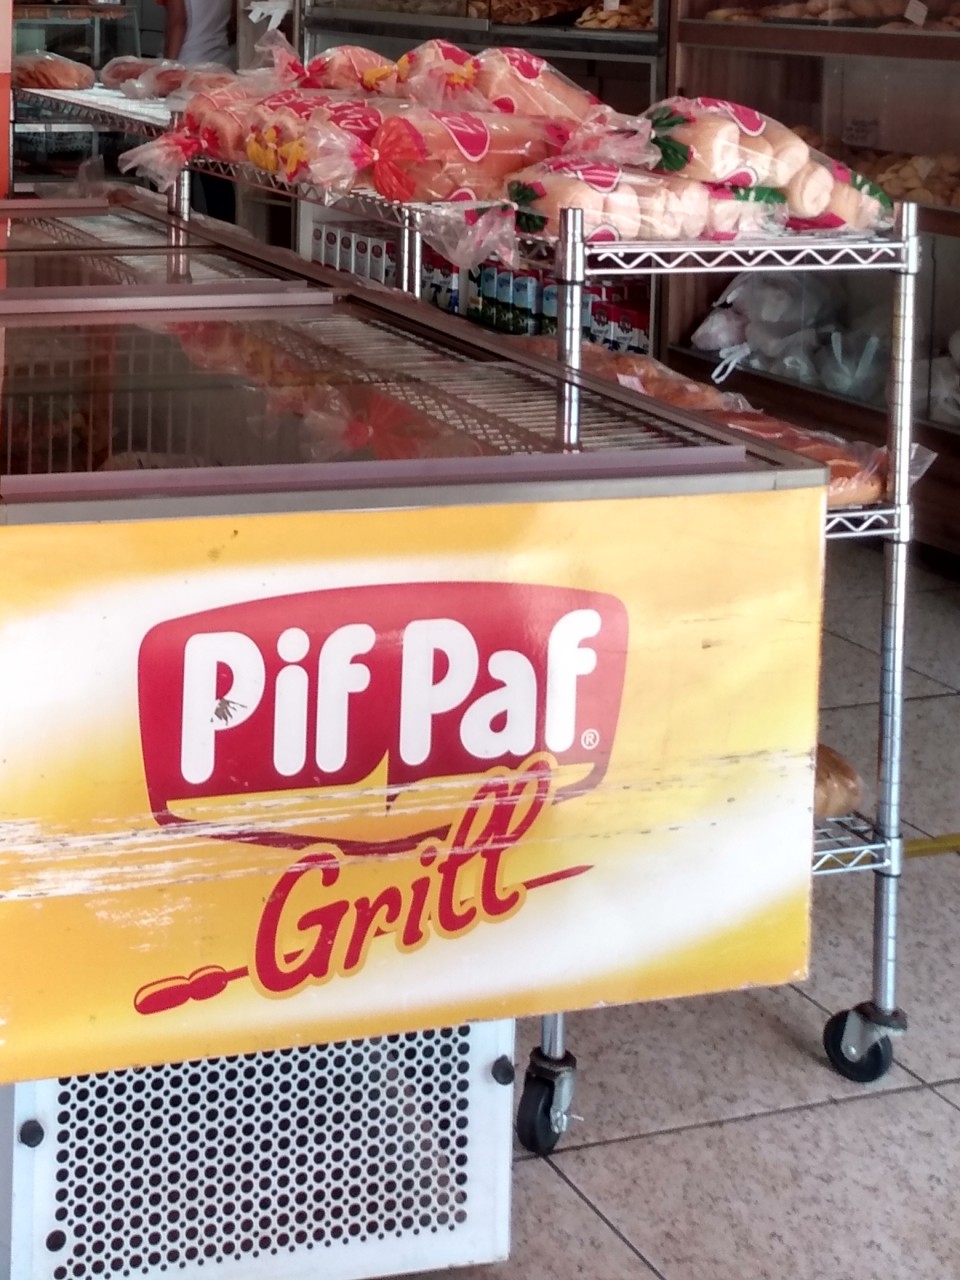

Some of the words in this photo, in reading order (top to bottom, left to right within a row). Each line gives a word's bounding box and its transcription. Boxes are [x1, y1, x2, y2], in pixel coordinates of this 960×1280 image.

[180, 623, 376, 785] Pif
[399, 609, 601, 767] Paf
[255, 760, 555, 994] Grill
